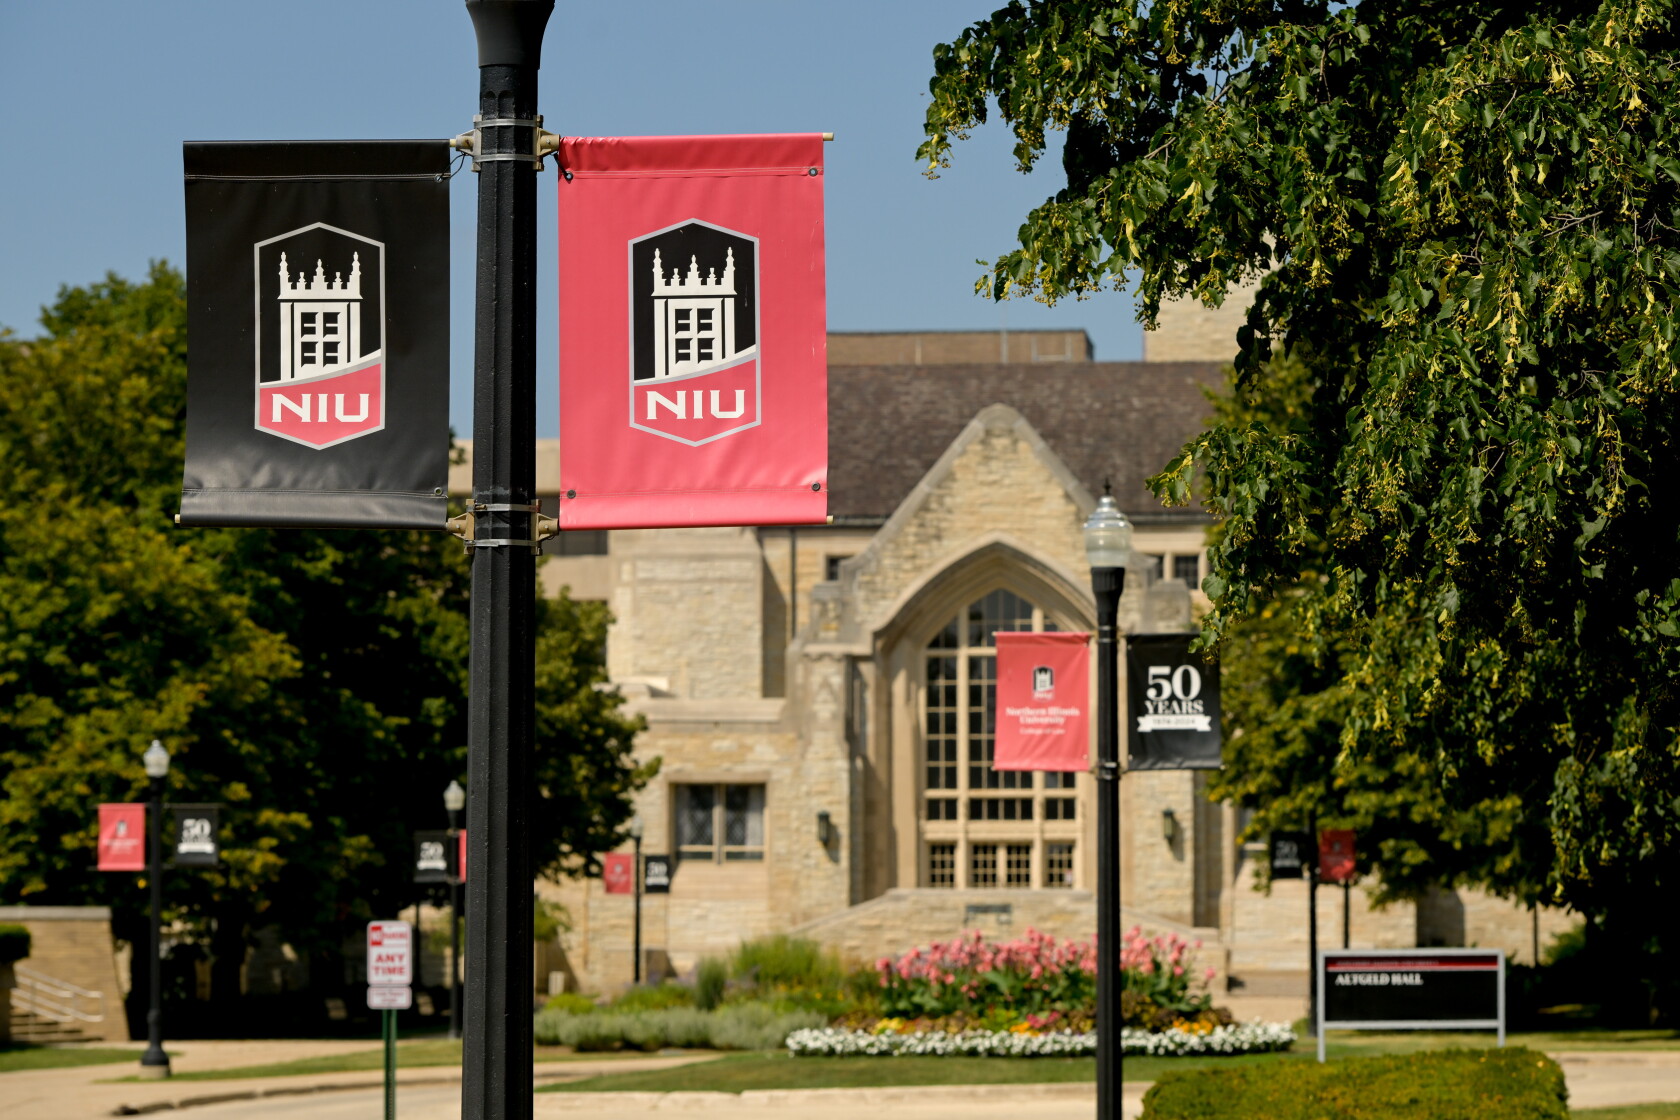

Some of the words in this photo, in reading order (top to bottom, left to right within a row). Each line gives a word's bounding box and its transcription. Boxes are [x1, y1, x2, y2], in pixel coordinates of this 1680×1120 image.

[271, 393, 369, 422] NIU
[646, 389, 745, 419] NIU
[1146, 664, 1201, 701] 50
[1005, 707, 1046, 716] Northern
[1048, 707, 1080, 716] Illinois
[1144, 699, 1204, 714] YEARS
[1019, 716, 1066, 726] University
[182, 818, 211, 839] 50
[375, 953, 404, 963] ANY
[374, 966, 405, 976] TIME
[1335, 973, 1390, 986] ALTGELD
[1391, 973, 1424, 986] HALL
